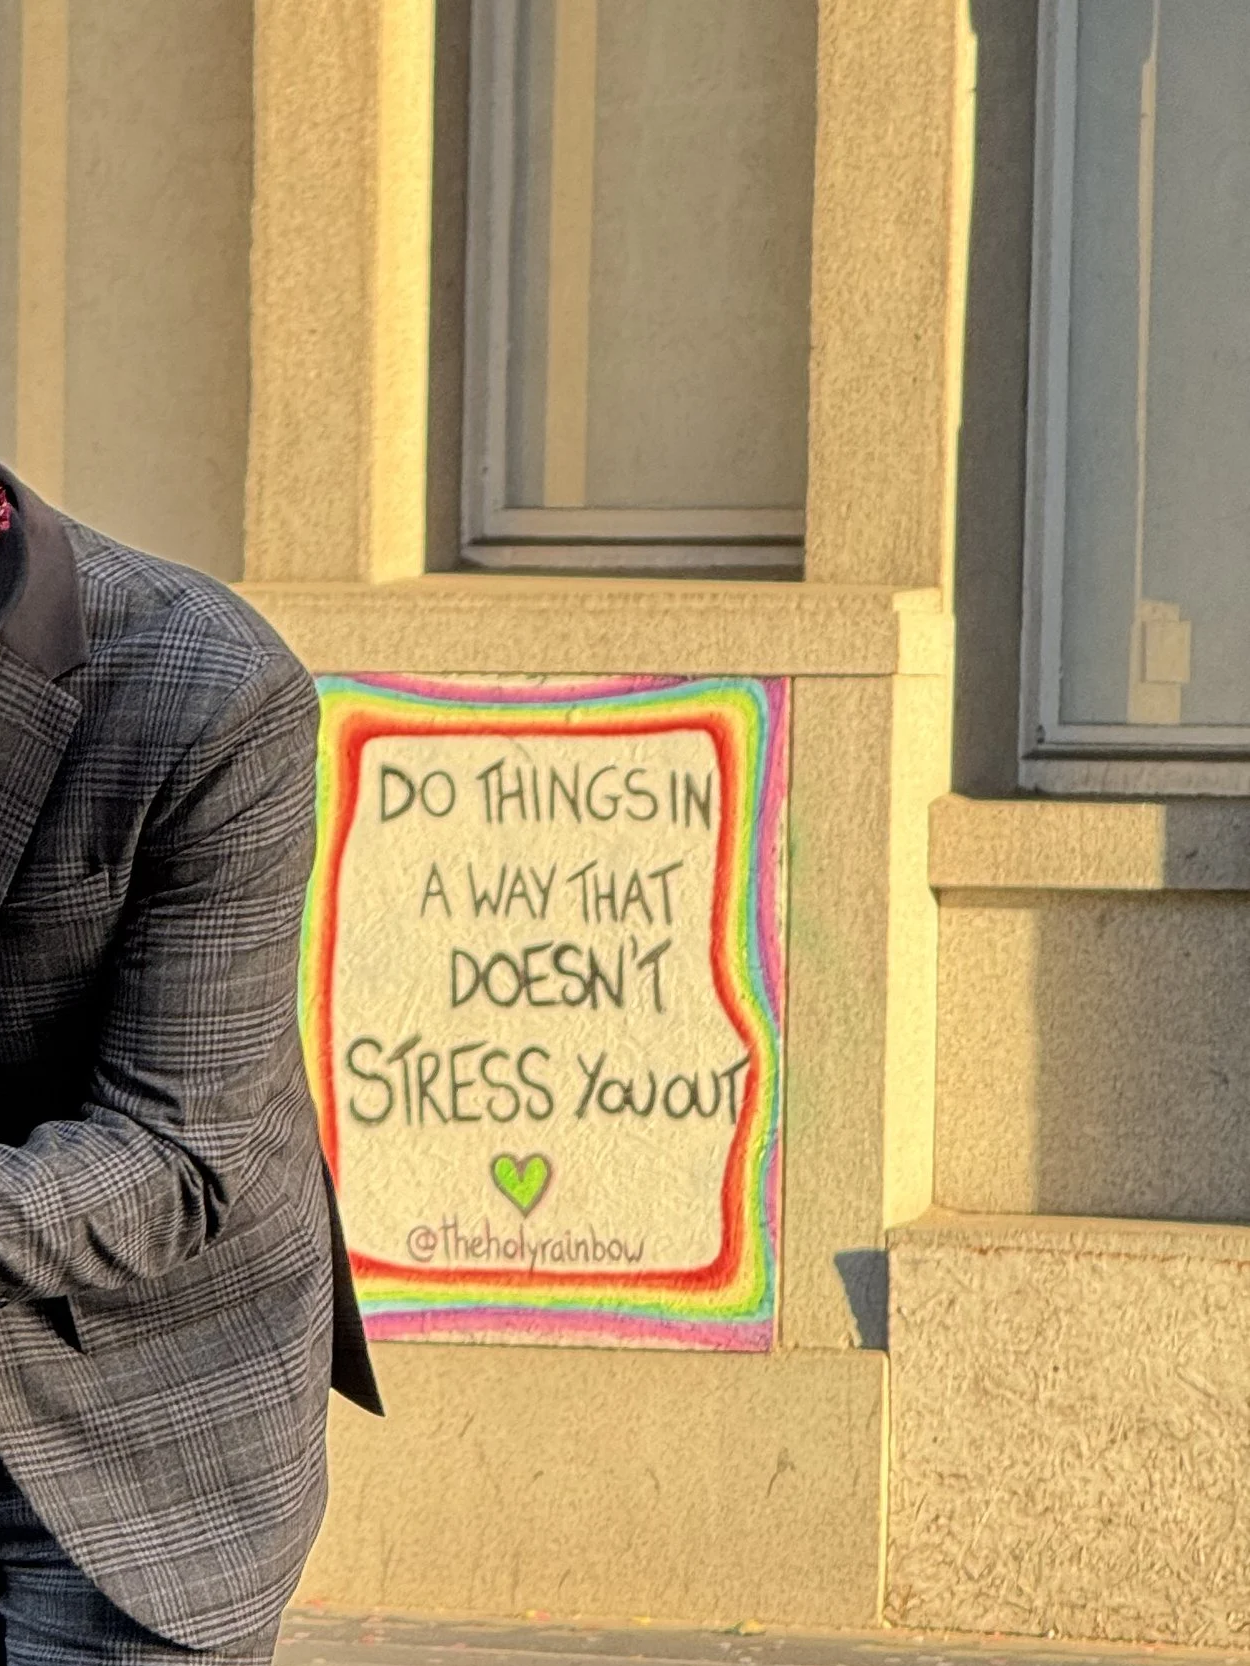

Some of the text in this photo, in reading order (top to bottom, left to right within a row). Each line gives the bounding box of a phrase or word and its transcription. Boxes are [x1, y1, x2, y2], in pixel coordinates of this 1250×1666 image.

[380, 757, 715, 830] DO THINGS IN
[420, 860, 685, 926] A WAY THAT
[450, 937, 673, 1014] DOESN'T
[346, 1034, 555, 1128] STRESS
[406, 1213, 646, 1272] @theholyrainbow
